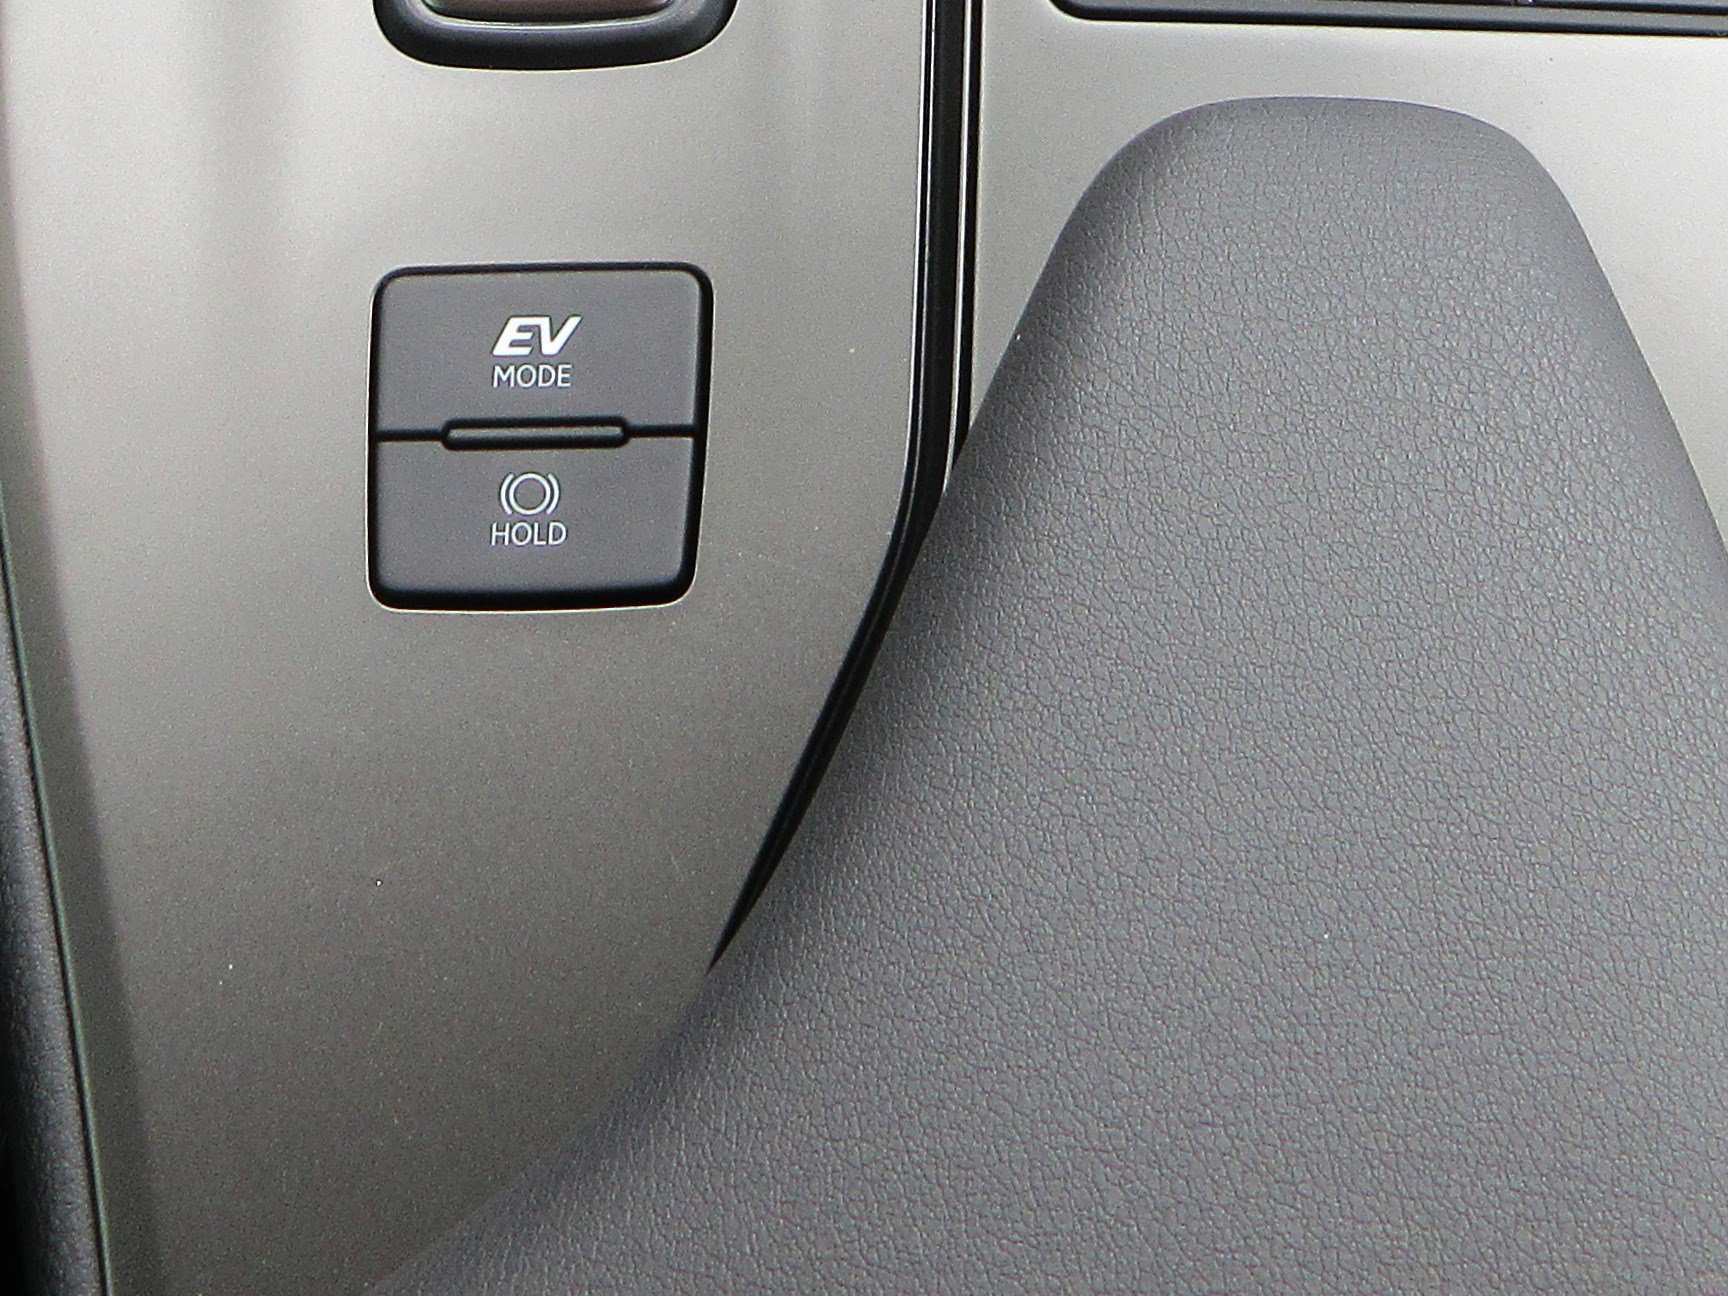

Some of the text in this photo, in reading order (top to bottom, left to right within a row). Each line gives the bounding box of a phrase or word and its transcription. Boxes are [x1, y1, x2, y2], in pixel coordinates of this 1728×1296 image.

[492, 314, 583, 357] EV
[493, 364, 573, 389] MODE
[491, 522, 567, 547] HOLD
